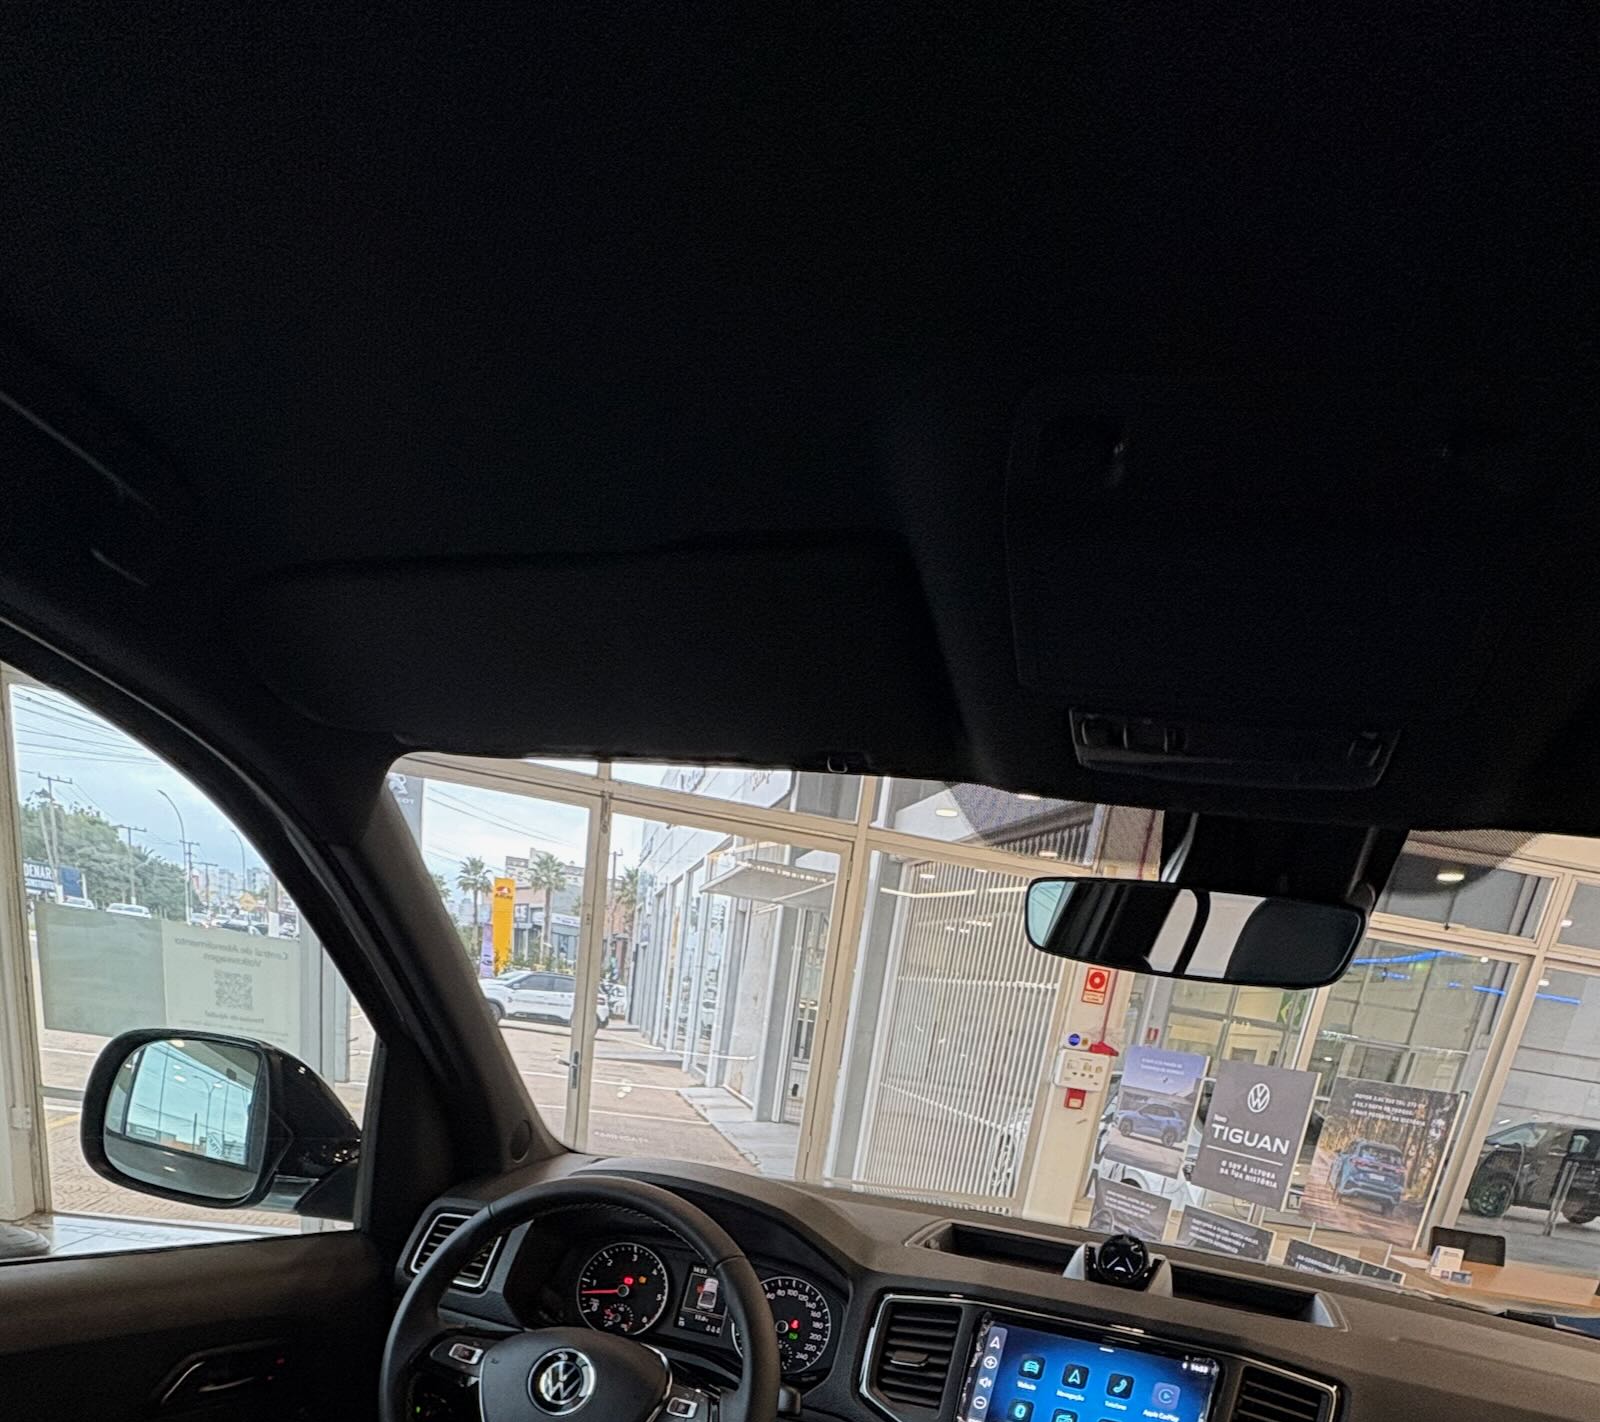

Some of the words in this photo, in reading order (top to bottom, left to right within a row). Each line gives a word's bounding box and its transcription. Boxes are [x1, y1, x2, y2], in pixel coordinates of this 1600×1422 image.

[1212, 1123, 1290, 1155] TIGUAN
[632, 1254, 638, 1262] 3
[787, 1289, 799, 1297] 100
[798, 1294, 809, 1302] 120
[805, 1301, 817, 1309] 140
[811, 1311, 821, 1319] 160
[812, 1321, 823, 1330] 180
[809, 1333, 822, 1341] 200
[804, 1344, 817, 1352] 220
[795, 1352, 808, 1361] 240
